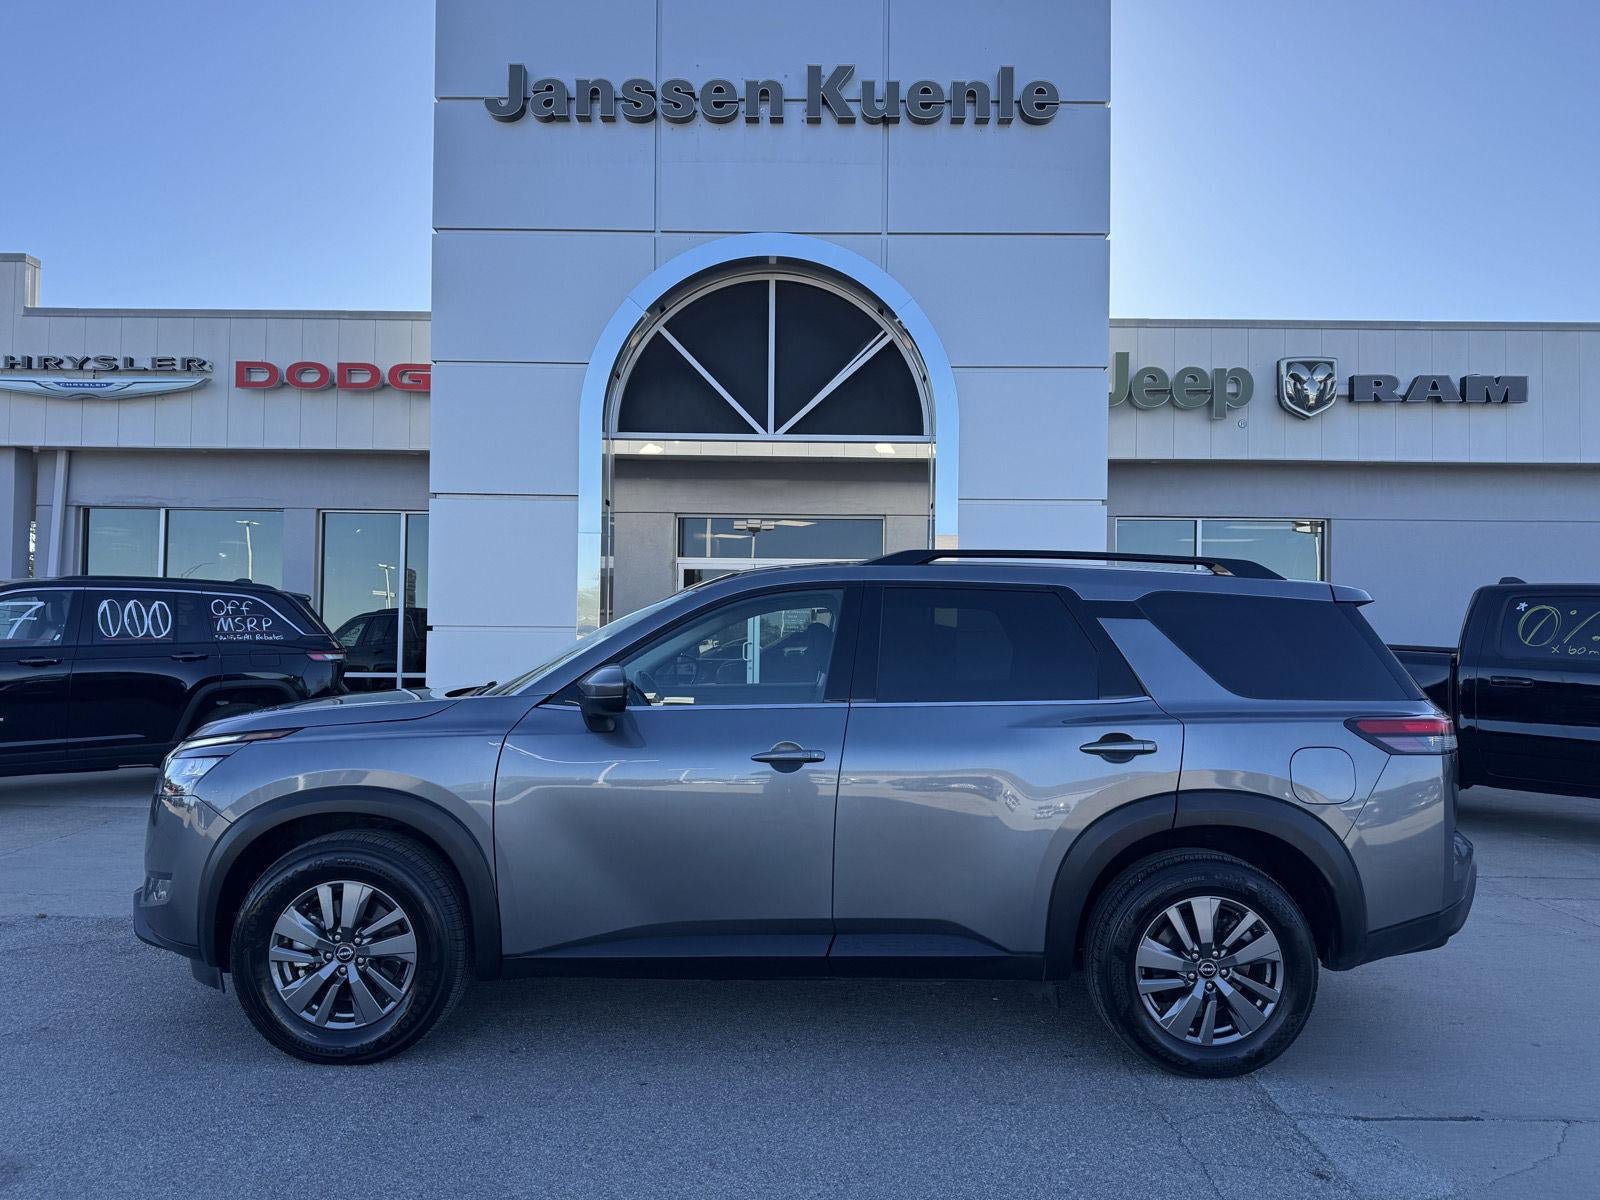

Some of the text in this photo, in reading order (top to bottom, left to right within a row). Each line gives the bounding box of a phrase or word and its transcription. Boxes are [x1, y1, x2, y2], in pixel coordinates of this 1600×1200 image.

[485, 63, 1061, 126] Janssen Kuenle
[3, 355, 208, 371] HRYSLER
[235, 361, 432, 391] DODG
[1109, 351, 1254, 419] Jeep
[1348, 374, 1529, 403] RAM
[97, 599, 172, 638] 000
[211, 599, 252, 616] Off
[216, 617, 272, 631] MSRP
